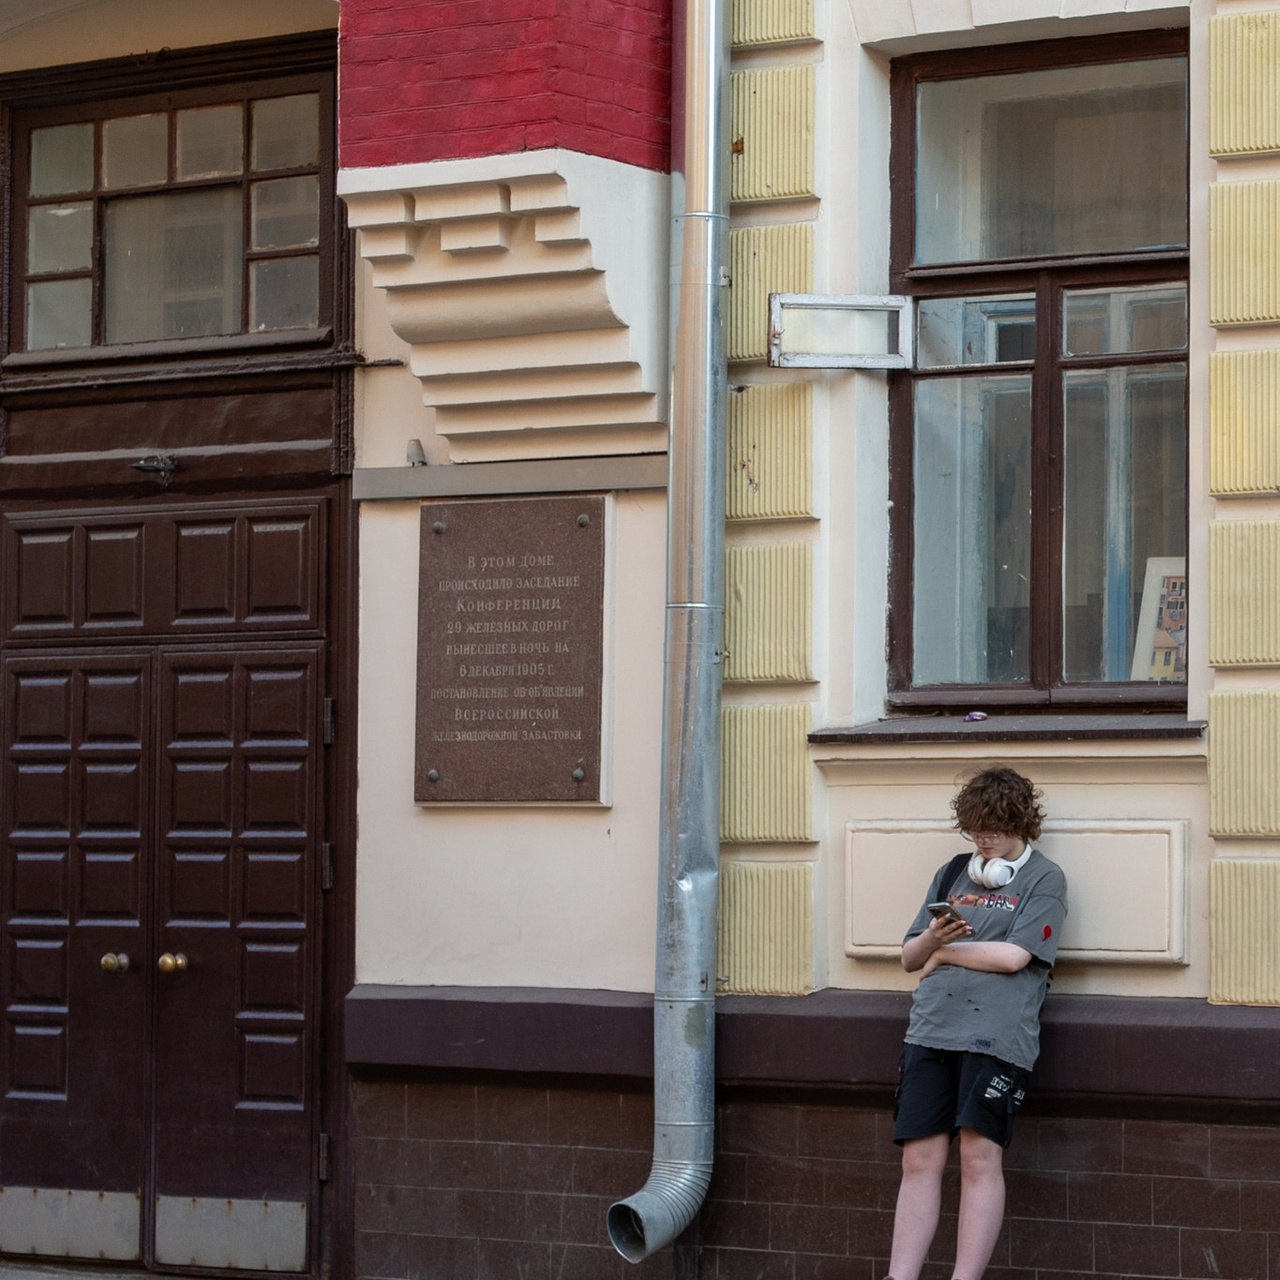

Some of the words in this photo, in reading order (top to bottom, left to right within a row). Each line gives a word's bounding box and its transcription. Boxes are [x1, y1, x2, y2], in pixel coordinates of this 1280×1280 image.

[468, 556, 476, 569] В
[480, 555, 515, 568] ЭТОМ
[518, 554, 555, 568] ДОМЕ
[438, 578, 513, 592] ПРОИСХОДИЛО
[516, 576, 581, 589] ЗАСЕДАНИЕ
[456, 598, 562, 612] КОНФЕРЕНЦИИ
[446, 621, 462, 634] 29
[465, 620, 529, 634] ЖЕЛЕЗНЫХ
[531, 620, 570, 633] ДОРОГ
[446, 642, 508, 656] ВЫНЕСШЕЕ
[510, 642, 517, 654] В
[519, 642, 550, 654] НОЧЬ
[554, 642, 570, 654] НА
[459, 664, 467, 677] 6
[468, 664, 515, 677] ДЕКАБРЯ
[516, 663, 545, 676] 1905
[430, 687, 509, 699] ПОСТАНОВЛЕНИЕ
[513, 686, 526, 698] ОБ
[454, 705, 559, 721] ВСЕРОССИЙСКОЙ
[432, 729, 518, 742] ЖЕЛЕЗНОДОРОЖНОЙ
[521, 729, 582, 741] ЗАБАСТОВКИ
